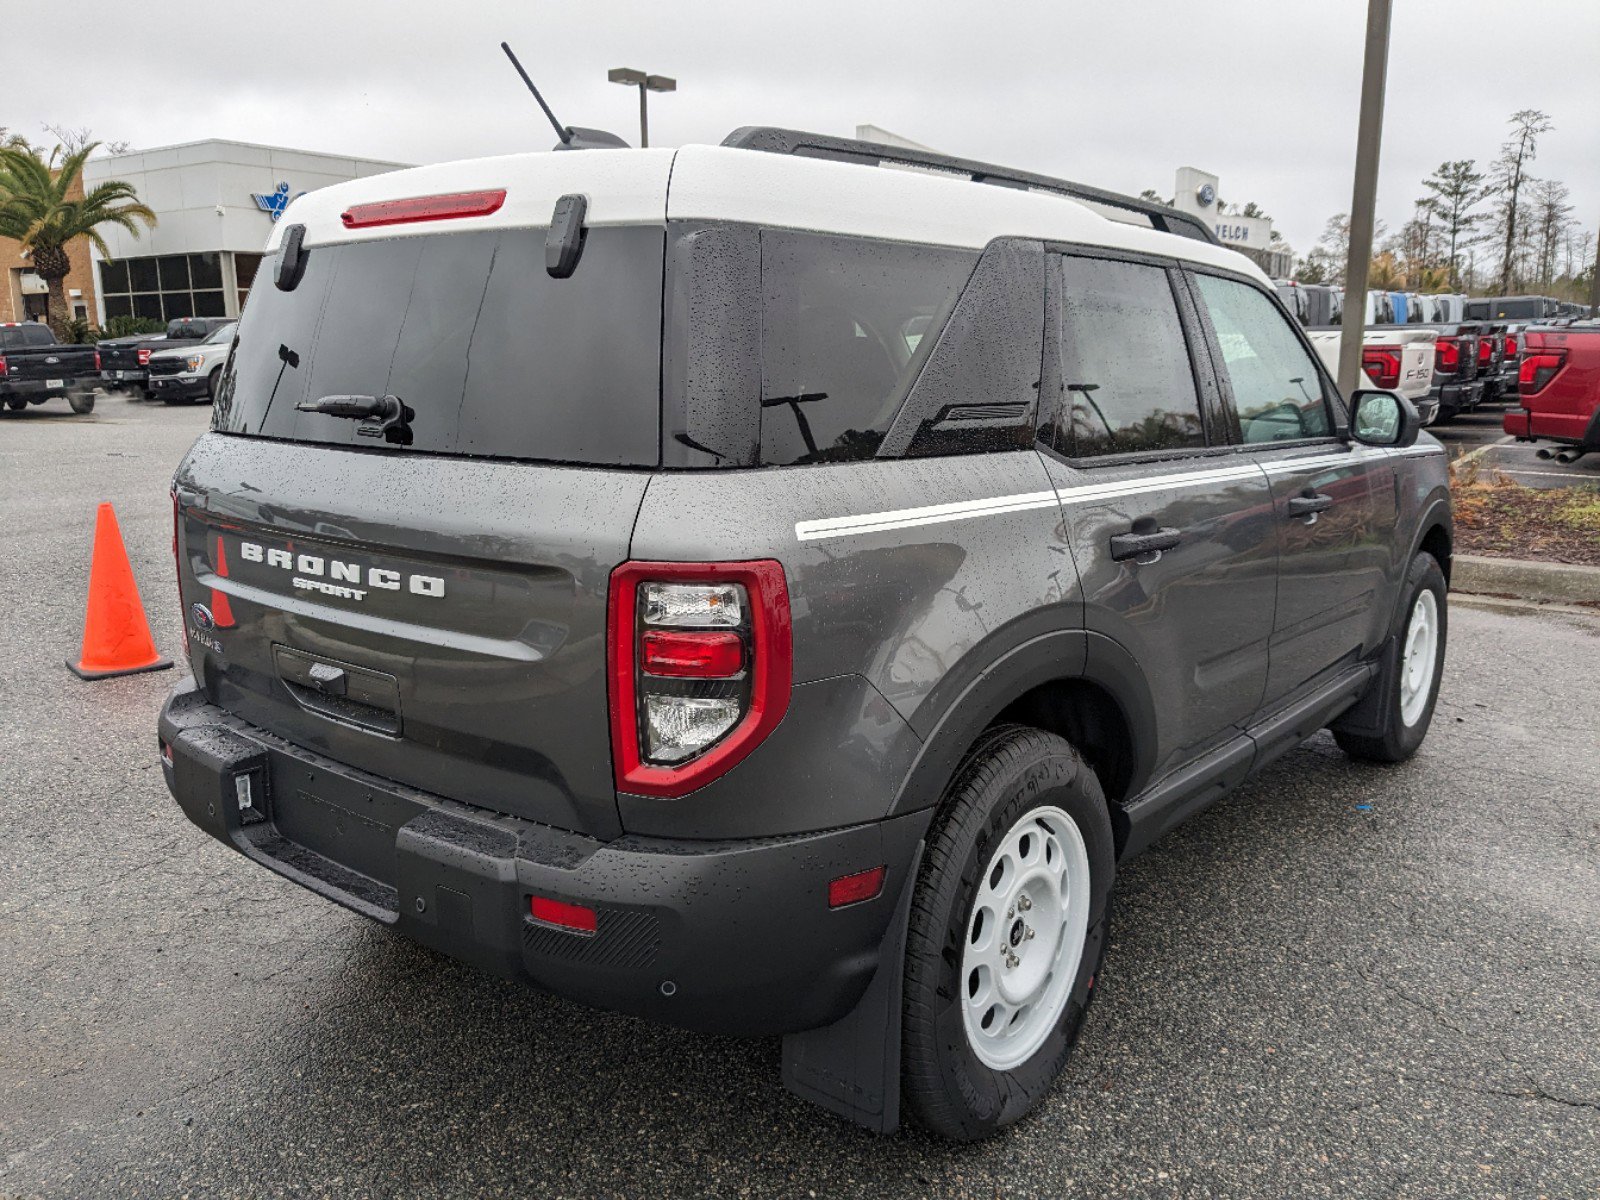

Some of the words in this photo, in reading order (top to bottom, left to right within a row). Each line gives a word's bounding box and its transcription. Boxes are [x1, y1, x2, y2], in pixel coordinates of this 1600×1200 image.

[1406, 368, 1430, 380] F-150
[241, 541, 446, 599] BRONCO
[292, 576, 368, 601] SPORT
